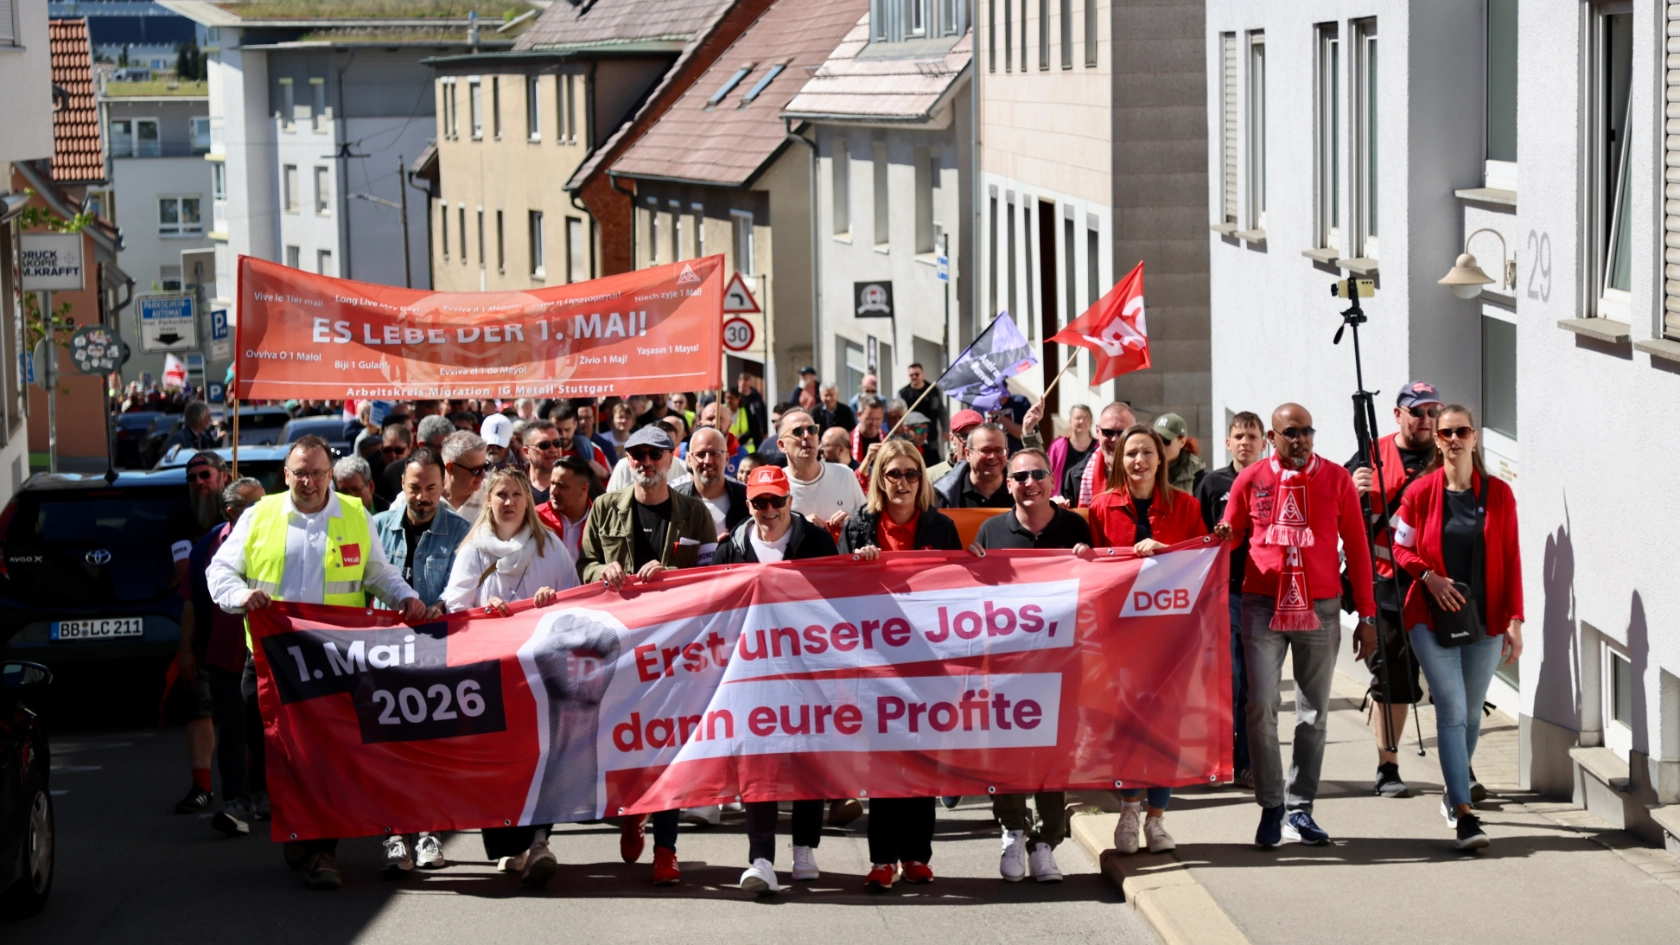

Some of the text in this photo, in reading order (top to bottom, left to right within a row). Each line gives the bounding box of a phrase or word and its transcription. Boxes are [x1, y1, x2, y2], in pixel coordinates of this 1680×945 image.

[1527, 229, 1551, 303] 29
[254, 292, 273, 301] Vive
[275, 294, 283, 302] le
[305, 299, 323, 308] mai!
[335, 294, 420, 313] Long Live May Day!
[634, 293, 659, 302] Niech
[152, 309, 182, 318] AUTOMAT
[214, 313, 223, 337] P
[312, 310, 647, 345] ES LEBE DER 1. MAI!
[727, 326, 747, 343] 30
[246, 349, 277, 359] Ovviva
[280, 351, 287, 359] O
[296, 352, 322, 361] Maio!
[579, 354, 600, 365] Živio
[609, 354, 628, 365] Maj!
[334, 360, 349, 370] Biji
[358, 360, 388, 369] Gulan!
[440, 367, 468, 376] Evviva
[487, 366, 498, 374] de
[500, 365, 527, 375] Mayo!
[210, 385, 221, 399] P
[346, 384, 615, 397] Arbeitskreis Migration IG Metall Stuttgart
[34, 555, 43, 563] X
[1133, 588, 1190, 612] DGB
[60, 619, 141, 637] BB LC 211
[634, 631, 728, 683] Erst
[738, 617, 911, 661] unsere
[925, 600, 1058, 643] Jobs,
[287, 634, 415, 682] 1. Mai
[372, 679, 486, 725] 2026
[612, 689, 1042, 752] dann eure Profite
